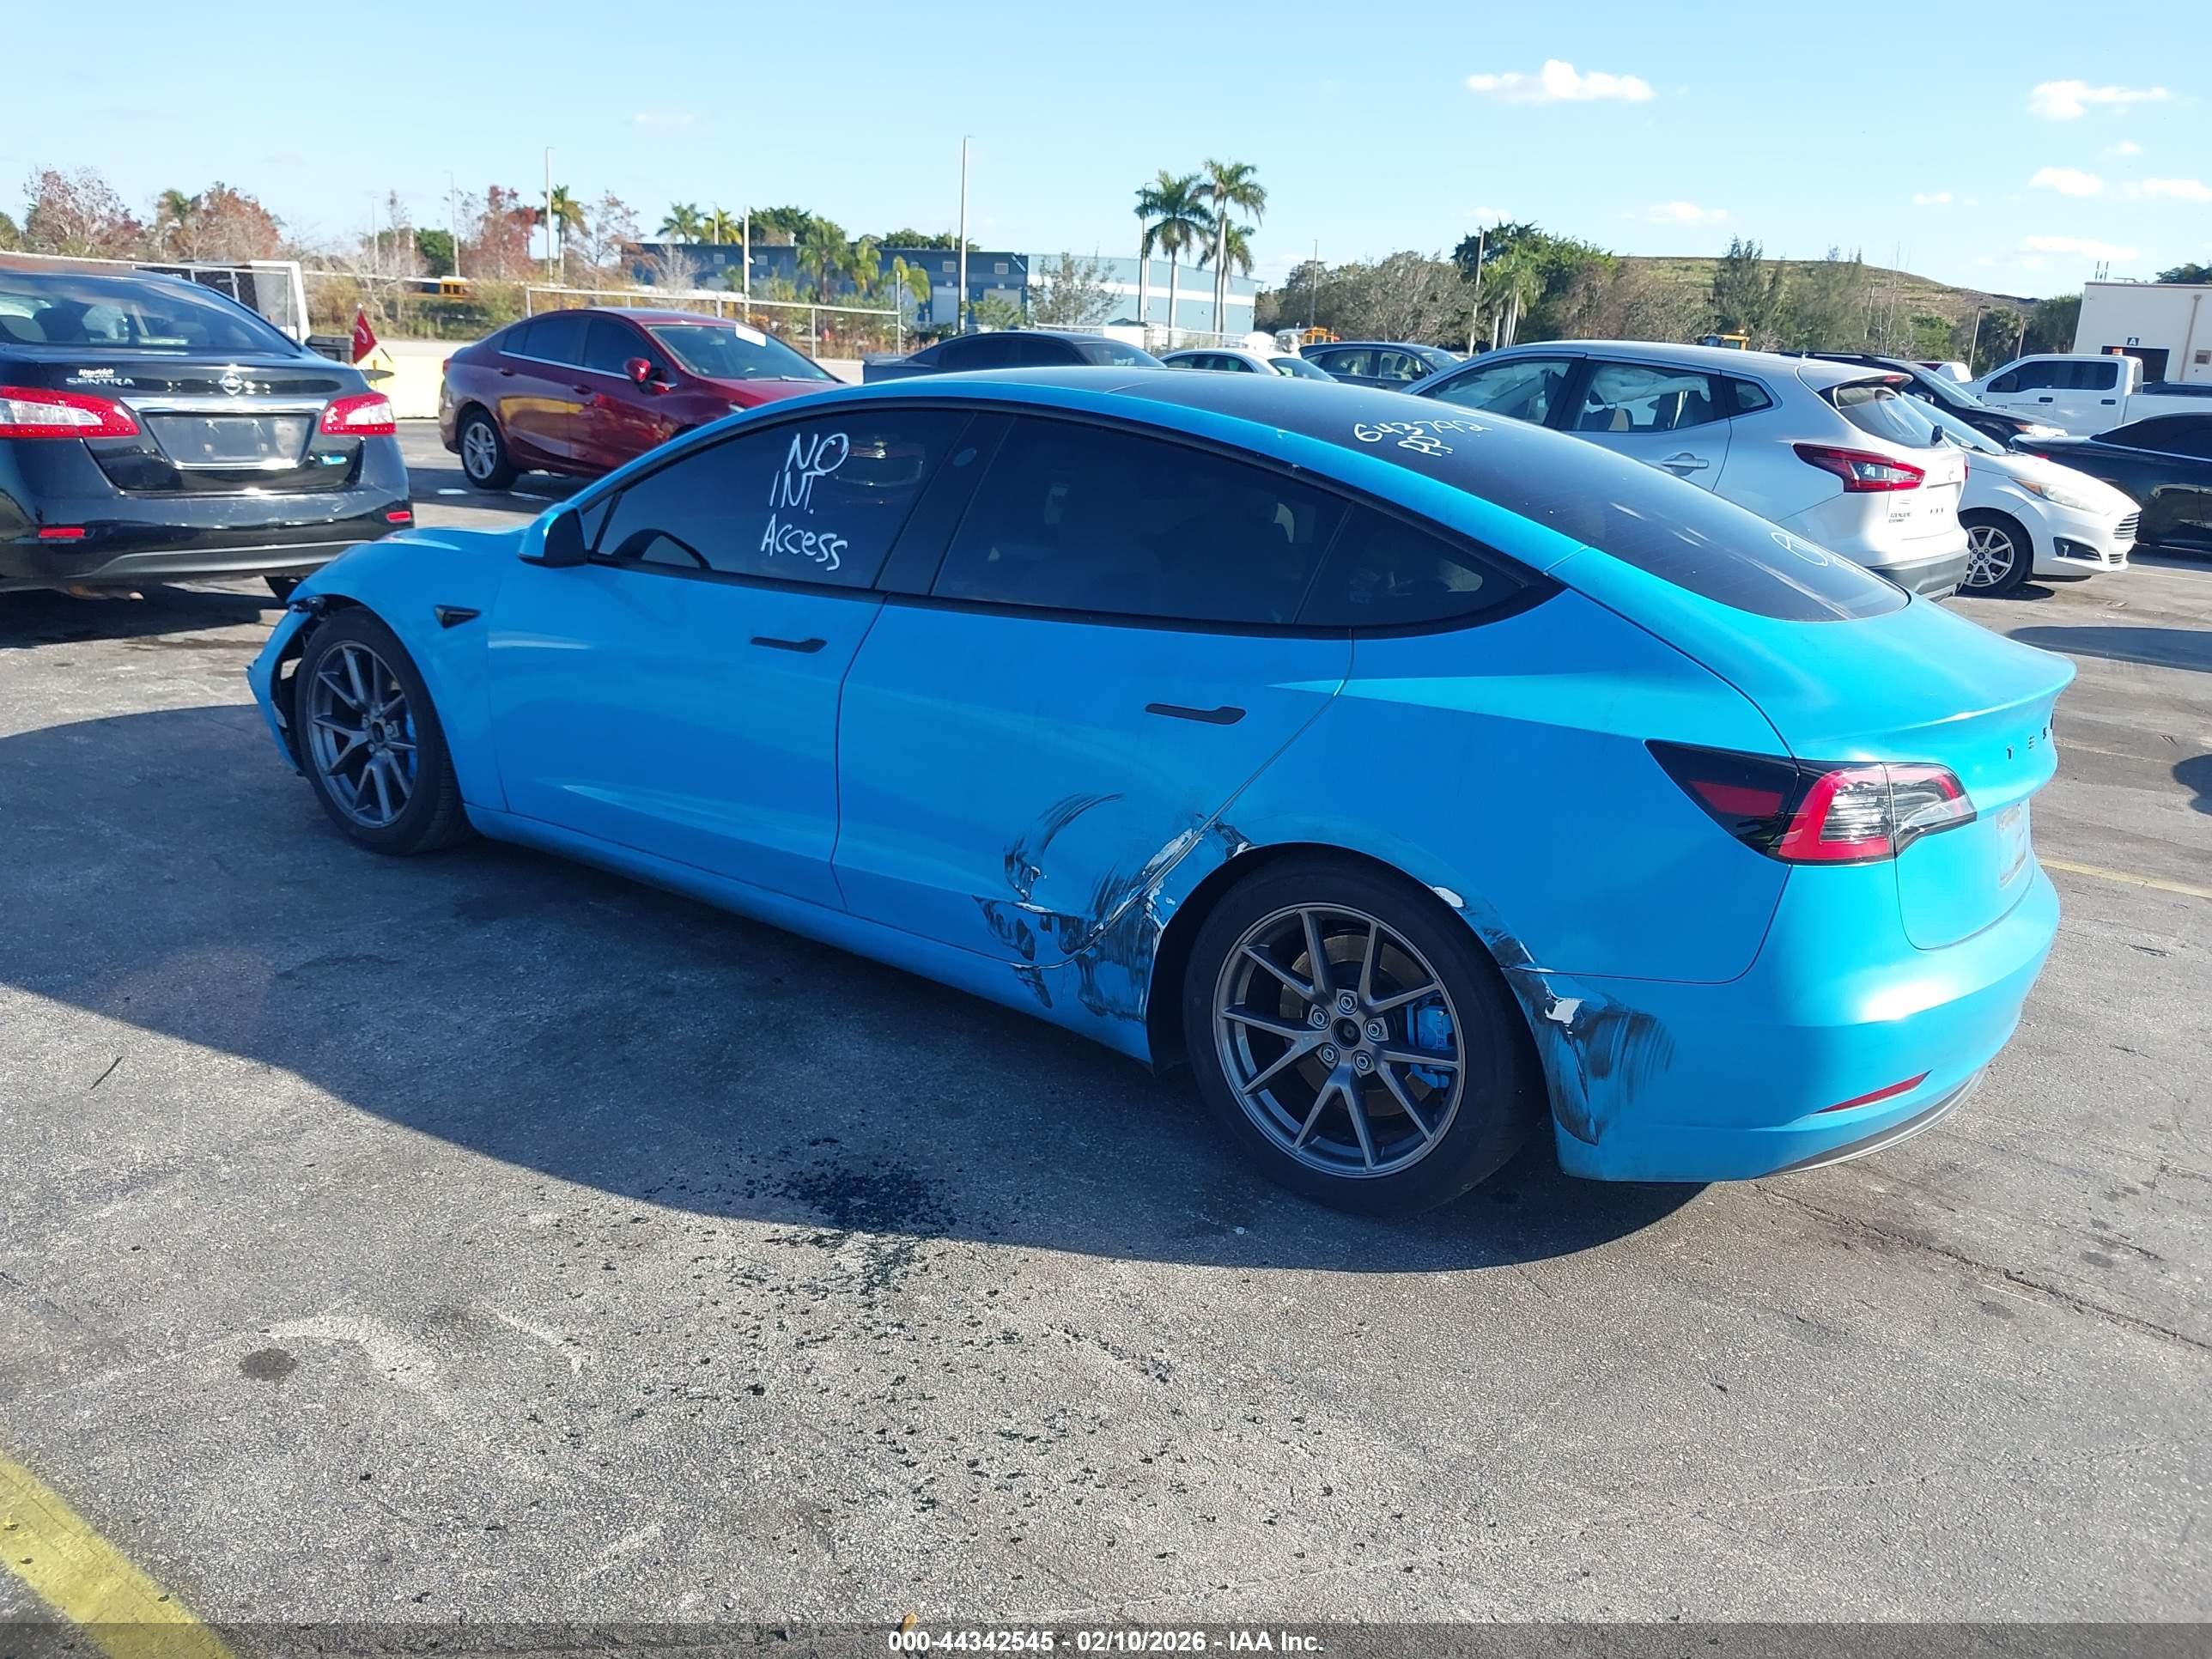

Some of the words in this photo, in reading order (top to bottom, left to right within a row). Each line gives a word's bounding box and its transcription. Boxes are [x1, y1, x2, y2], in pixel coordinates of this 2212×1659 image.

[2129, 337, 2137, 346] A
[65, 378, 136, 386] SENTRA
[1353, 420, 1493, 442] 643792
[785, 432, 850, 472] NO
[759, 513, 848, 572] Access
[2006, 712, 2054, 760] TES
